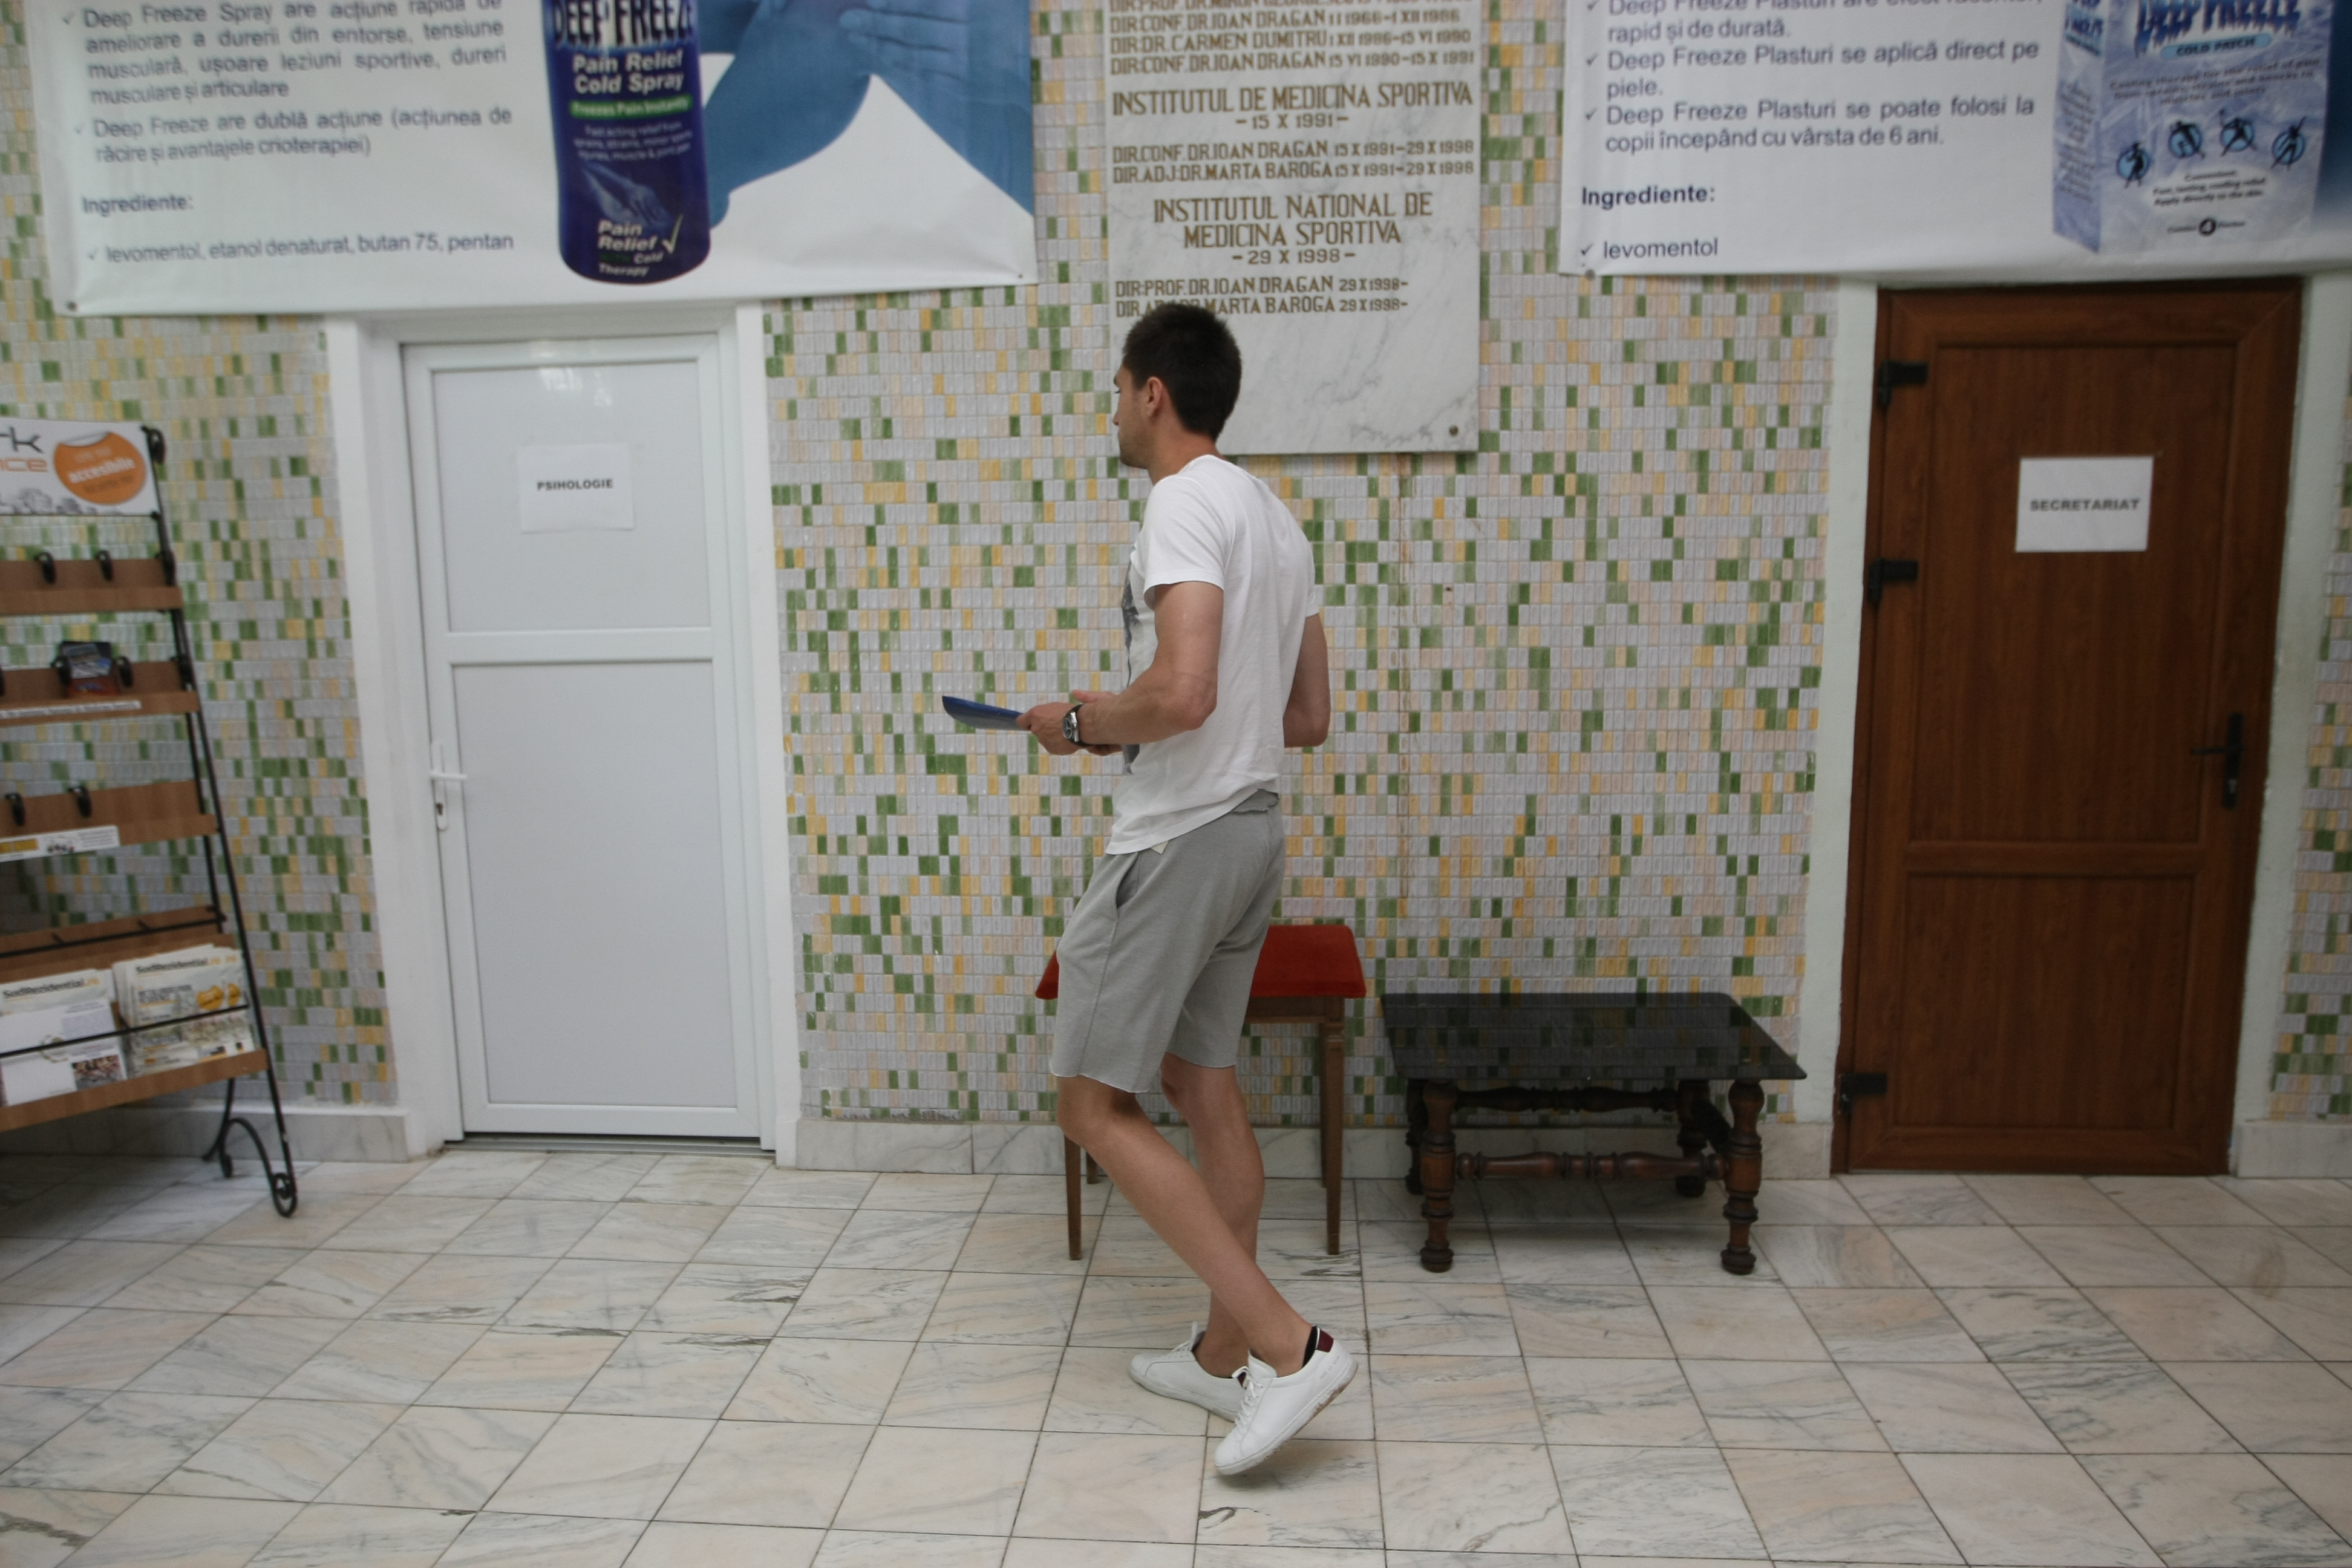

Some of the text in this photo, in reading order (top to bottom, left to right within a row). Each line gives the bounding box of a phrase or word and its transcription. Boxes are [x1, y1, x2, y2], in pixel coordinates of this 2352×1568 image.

[83, 7, 132, 29] Deep
[143, 5, 207, 23] Freeze
[220, 3, 272, 25] Spray
[284, 2, 317, 19] are
[1256, 9, 1325, 28] DRAGAN
[86, 33, 182, 53] ameliorare
[192, 32, 207, 47] a
[291, 27, 319, 44] din
[423, 18, 504, 41] tensiune
[1172, 32, 1247, 52] CARMEN
[1252, 30, 1327, 49] DUMITRU
[1607, 20, 1661, 46] rapid
[1687, 19, 1714, 39] de
[280, 48, 342, 71] leziuni
[451, 44, 507, 66] dureri
[573, 48, 684, 74] Pain Relief
[1256, 51, 1326, 70] DRAGAN
[1607, 49, 1665, 71] Deep
[1673, 45, 1747, 66] Freeze
[1755, 44, 1834, 65] Plasturi
[1841, 46, 1866, 64] se
[1874, 41, 1938, 68] aplică
[1945, 39, 2005, 60] direct
[2011, 41, 2039, 64] pe
[90, 83, 182, 105] musculare
[201, 80, 290, 99] articulare
[575, 71, 685, 95] Cold Spray
[1607, 77, 1664, 101] piele.
[1112, 81, 1474, 116] INSTITUTUL DE MEDICINA SPORTIVA
[1606, 93, 2035, 126] Deep Freeze Plasturi se poate folosi la
[93, 117, 144, 140] Deep
[149, 116, 209, 134] Freeze
[217, 114, 246, 131] are
[489, 103, 512, 125] de
[1277, 113, 1289, 129] X
[166, 139, 255, 162] avantajele
[1258, 140, 1328, 159] DRAGAN
[1333, 143, 1348, 157] 15
[1351, 143, 1361, 157] X
[1426, 140, 1436, 155] X
[1606, 125, 1944, 155] copii începând cu vârsta de 6 ani.
[1265, 160, 1333, 180] BAROGA
[1334, 164, 1348, 178] 15
[1351, 163, 1361, 177] X
[1427, 161, 1436, 175] X
[83, 194, 193, 217] Ingrediente:
[1154, 191, 1433, 223] INSTITUTUL NATIONAL DE
[1581, 185, 1716, 211] Ingrediente:
[598, 219, 643, 237] Pain
[1184, 220, 1402, 249] MEDICINA SPORTIVA
[210, 238, 263, 259] etanol
[358, 234, 411, 253] butan
[448, 232, 514, 254] pentan
[598, 234, 658, 252] Relief
[1603, 237, 1718, 260] levomentol
[633, 251, 665, 264] Cold
[1279, 249, 1290, 264] X
[1259, 275, 1333, 294] DRAGAN
[1339, 278, 1356, 292] 29
[1359, 278, 1367, 292] X
[1266, 296, 1335, 314] BAROGA
[1339, 298, 1356, 312] 29
[1359, 298, 1367, 312] X
[537, 477, 613, 491] PSIHOLOGIE
[2030, 498, 2140, 512] SECRETARIAT
